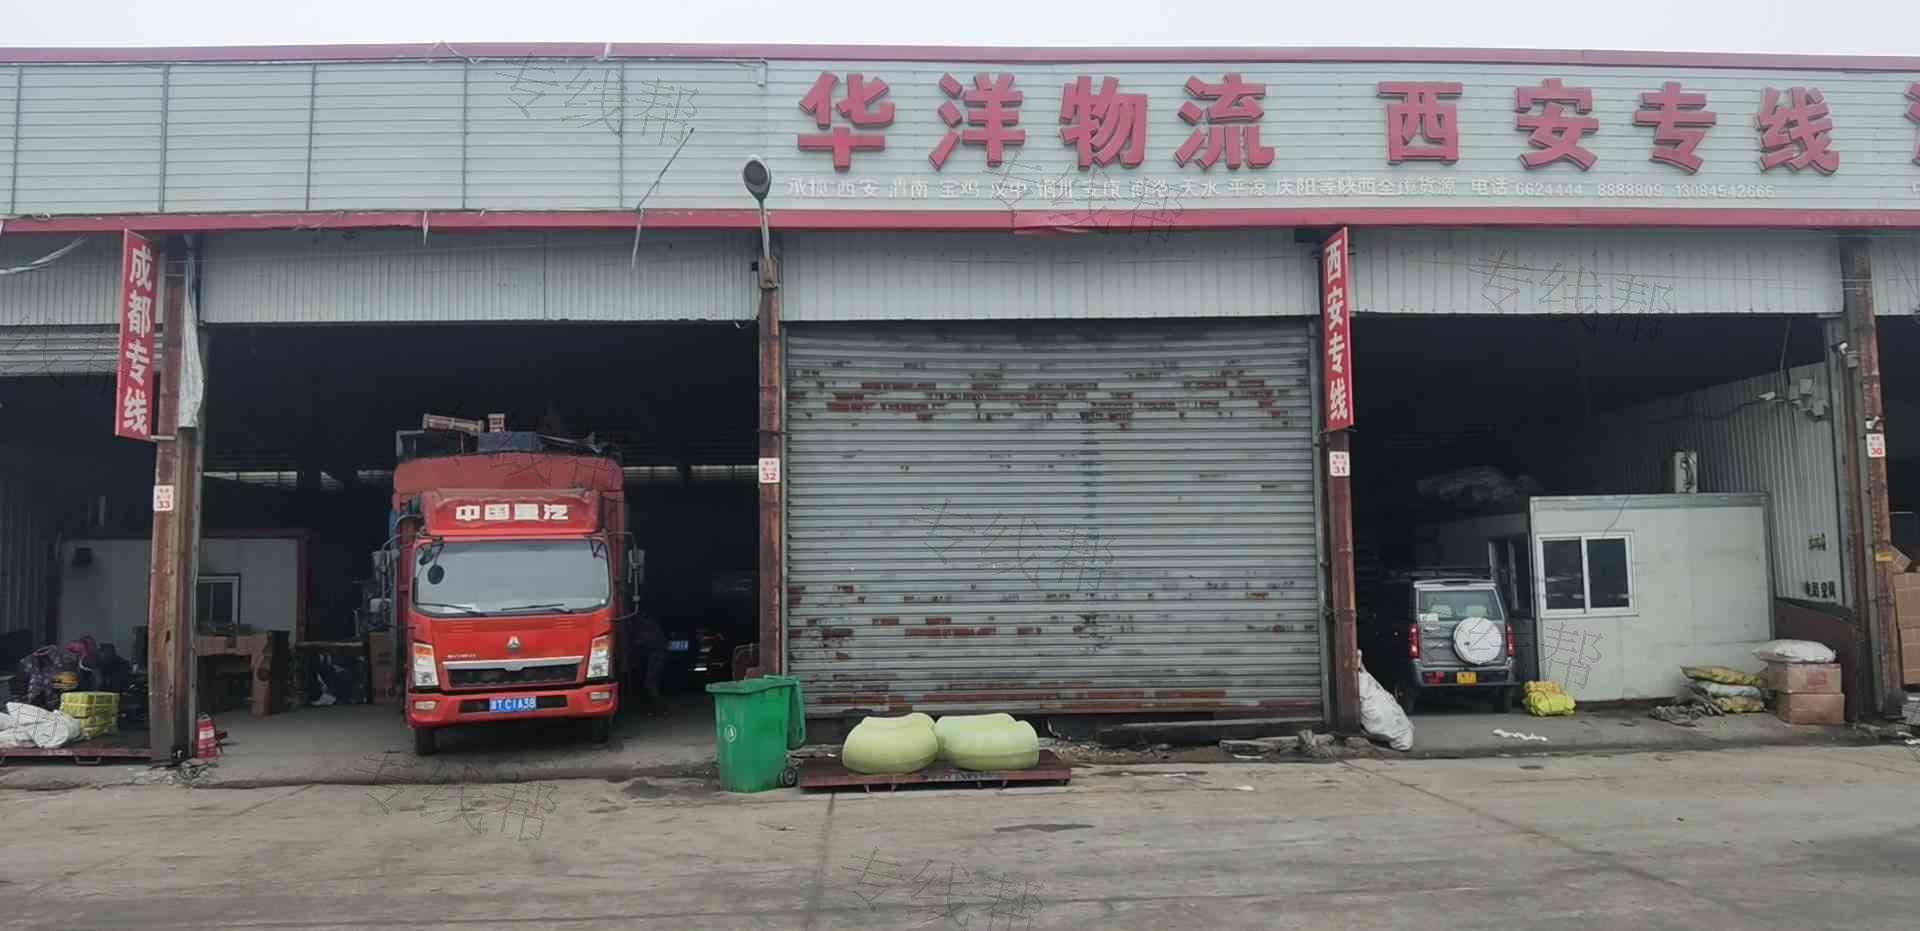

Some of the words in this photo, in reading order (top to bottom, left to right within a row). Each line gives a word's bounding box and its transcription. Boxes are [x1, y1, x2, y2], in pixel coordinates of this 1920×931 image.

[798, 71, 1276, 172] 华洋物流
[1376, 77, 1841, 176] 西安专线
[838, 177, 879, 198] 西安
[888, 177, 928, 198] 渭南
[939, 177, 979, 198] 宝鸡
[991, 178, 1026, 198] 汉中
[1181, 178, 1219, 197] 天水
[1228, 178, 1265, 197] 平凉
[1471, 177, 1508, 196] 电话
[123, 245, 152, 435] 成都专线
[1326, 239, 1348, 420] 西安专线
[456, 504, 569, 521] 中国重汽
